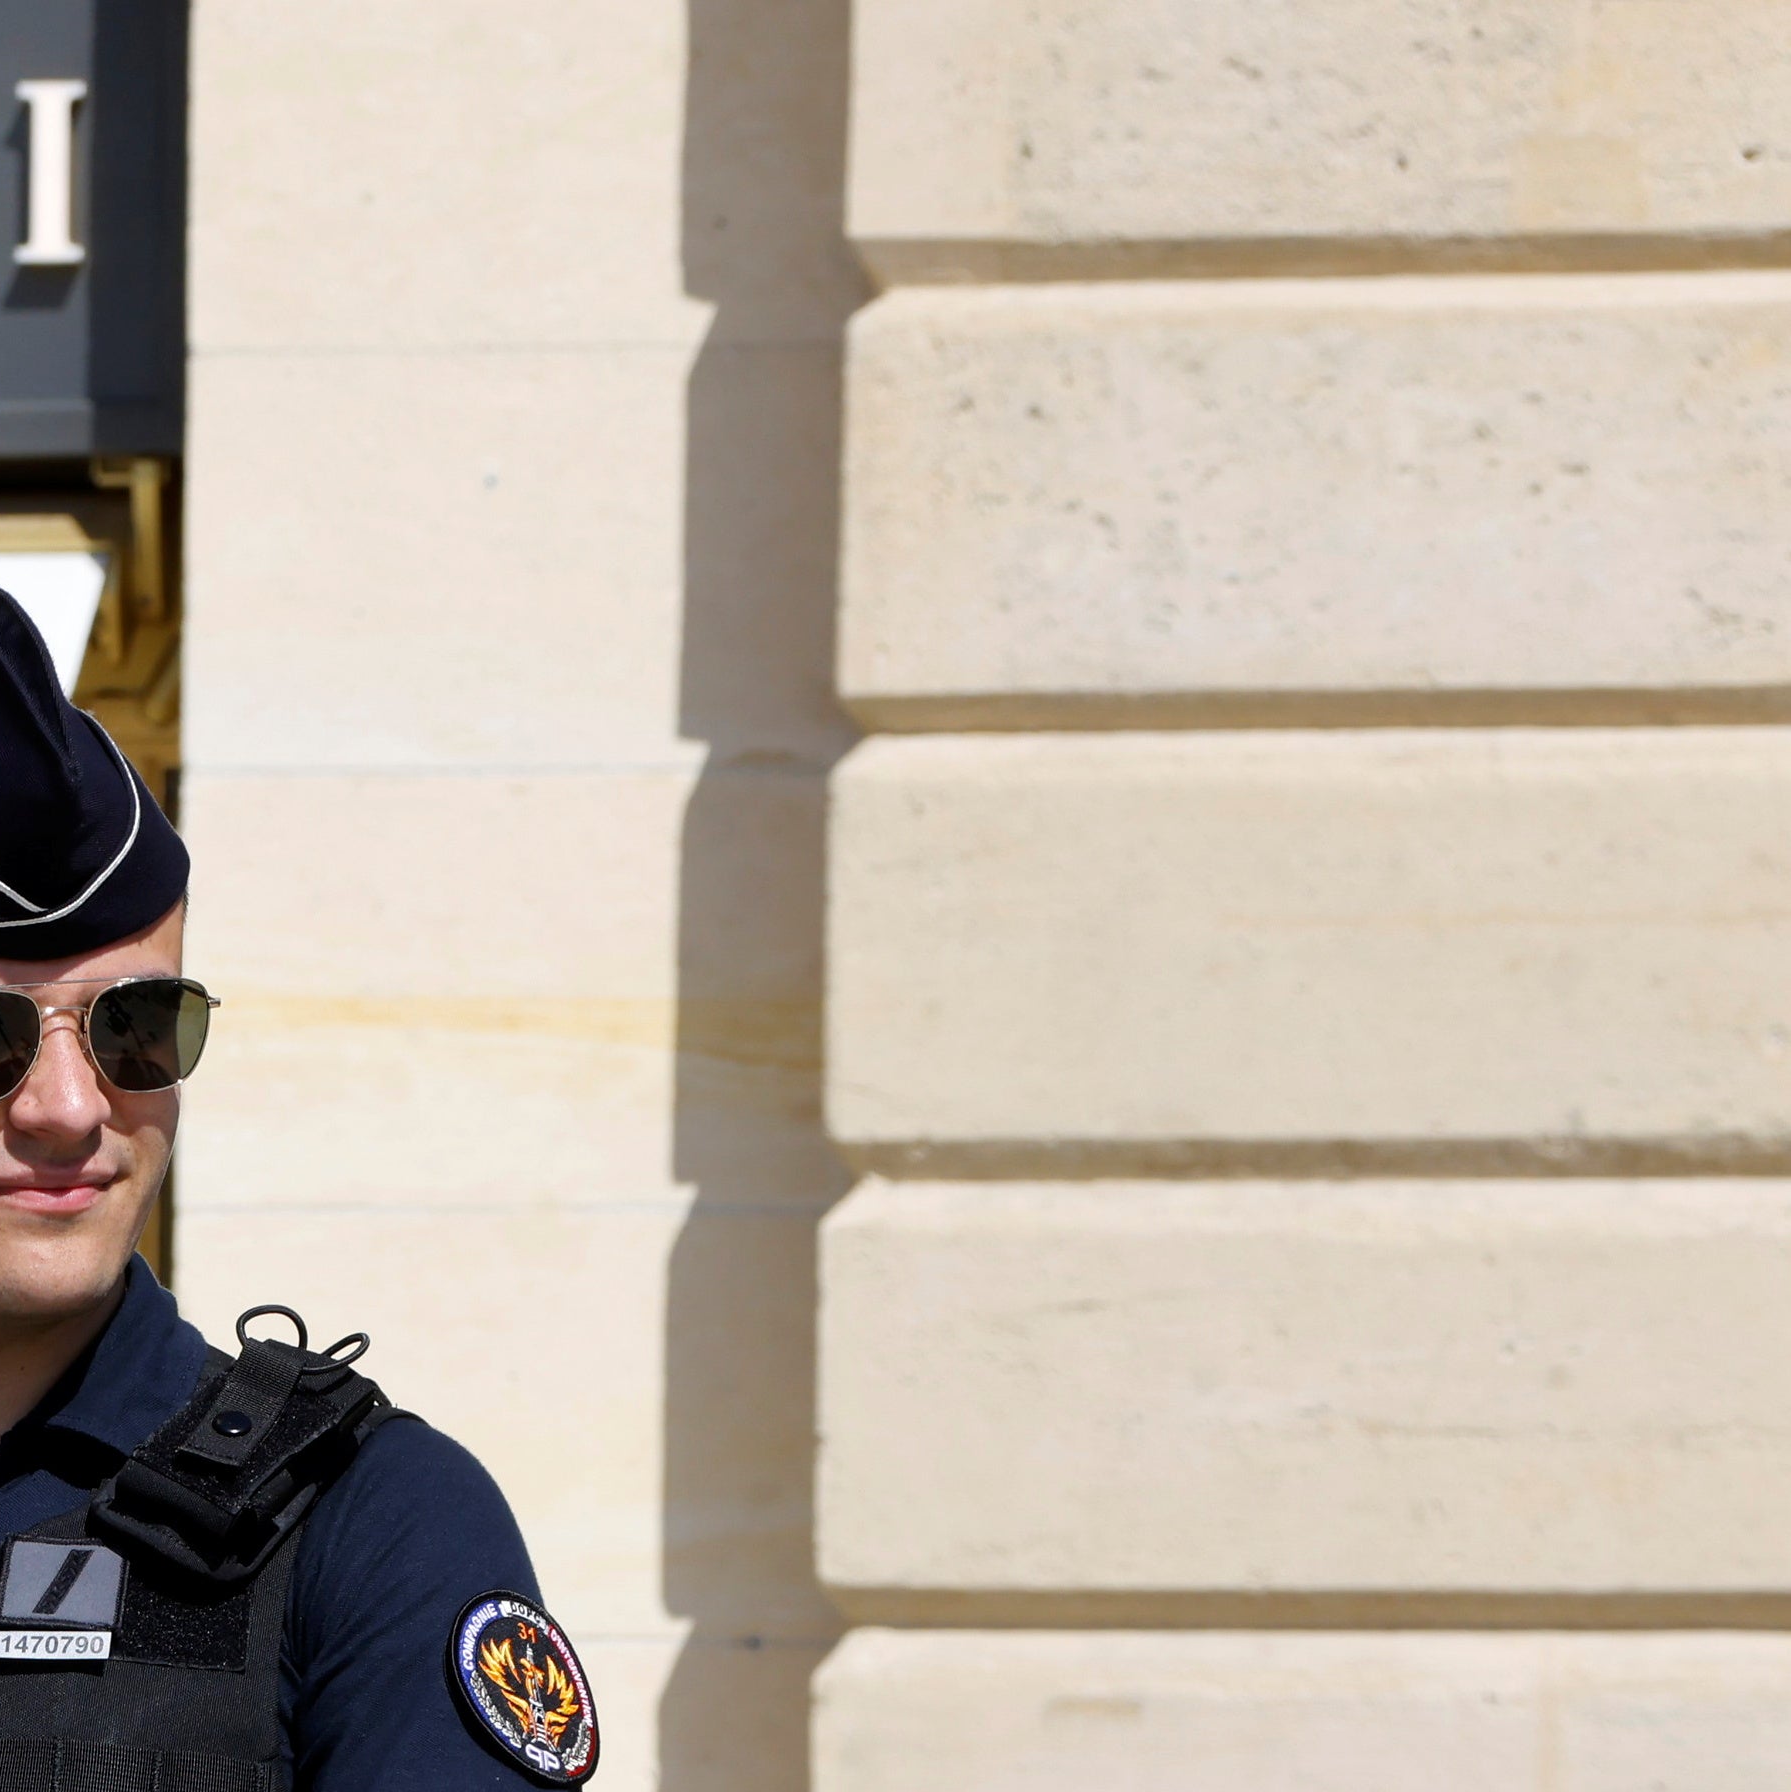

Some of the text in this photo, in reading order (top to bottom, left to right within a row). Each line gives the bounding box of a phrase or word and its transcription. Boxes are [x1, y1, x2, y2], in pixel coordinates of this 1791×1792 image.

[463, 1603, 499, 1671] COMPAGNIE
[517, 1622, 536, 1644] 31
[1, 1635, 105, 1655] 1470790
